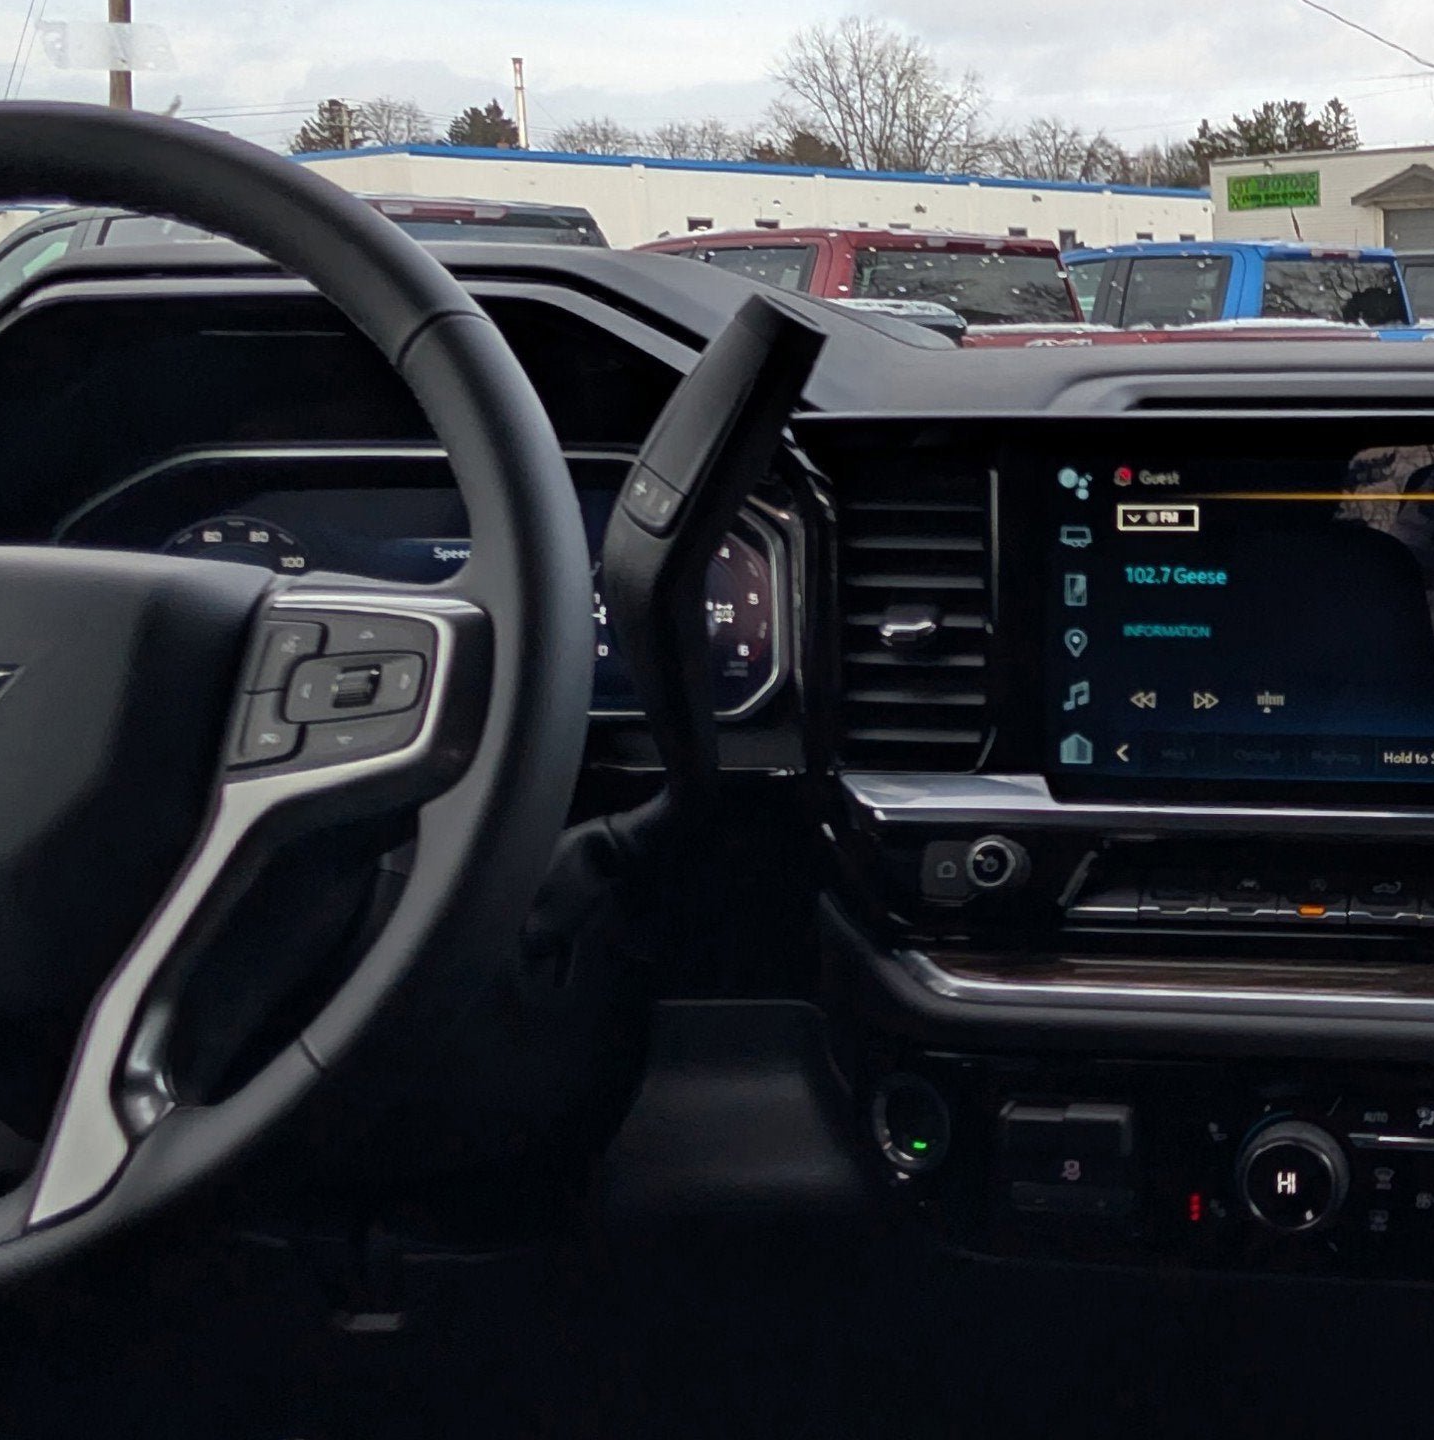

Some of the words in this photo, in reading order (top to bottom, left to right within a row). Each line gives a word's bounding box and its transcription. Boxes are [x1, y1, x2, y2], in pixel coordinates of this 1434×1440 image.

[1138, 469, 1181, 486] Guest
[433, 546, 472, 562] Spee
[1125, 567, 1171, 585] 102.7
[1174, 568, 1228, 586] Geese
[1123, 624, 1211, 639] INFORMATION
[1384, 752, 1412, 764] Hold
[1415, 753, 1428, 764] to
[1363, 1111, 1389, 1125] AUTO
[1276, 1171, 1298, 1196] HI
